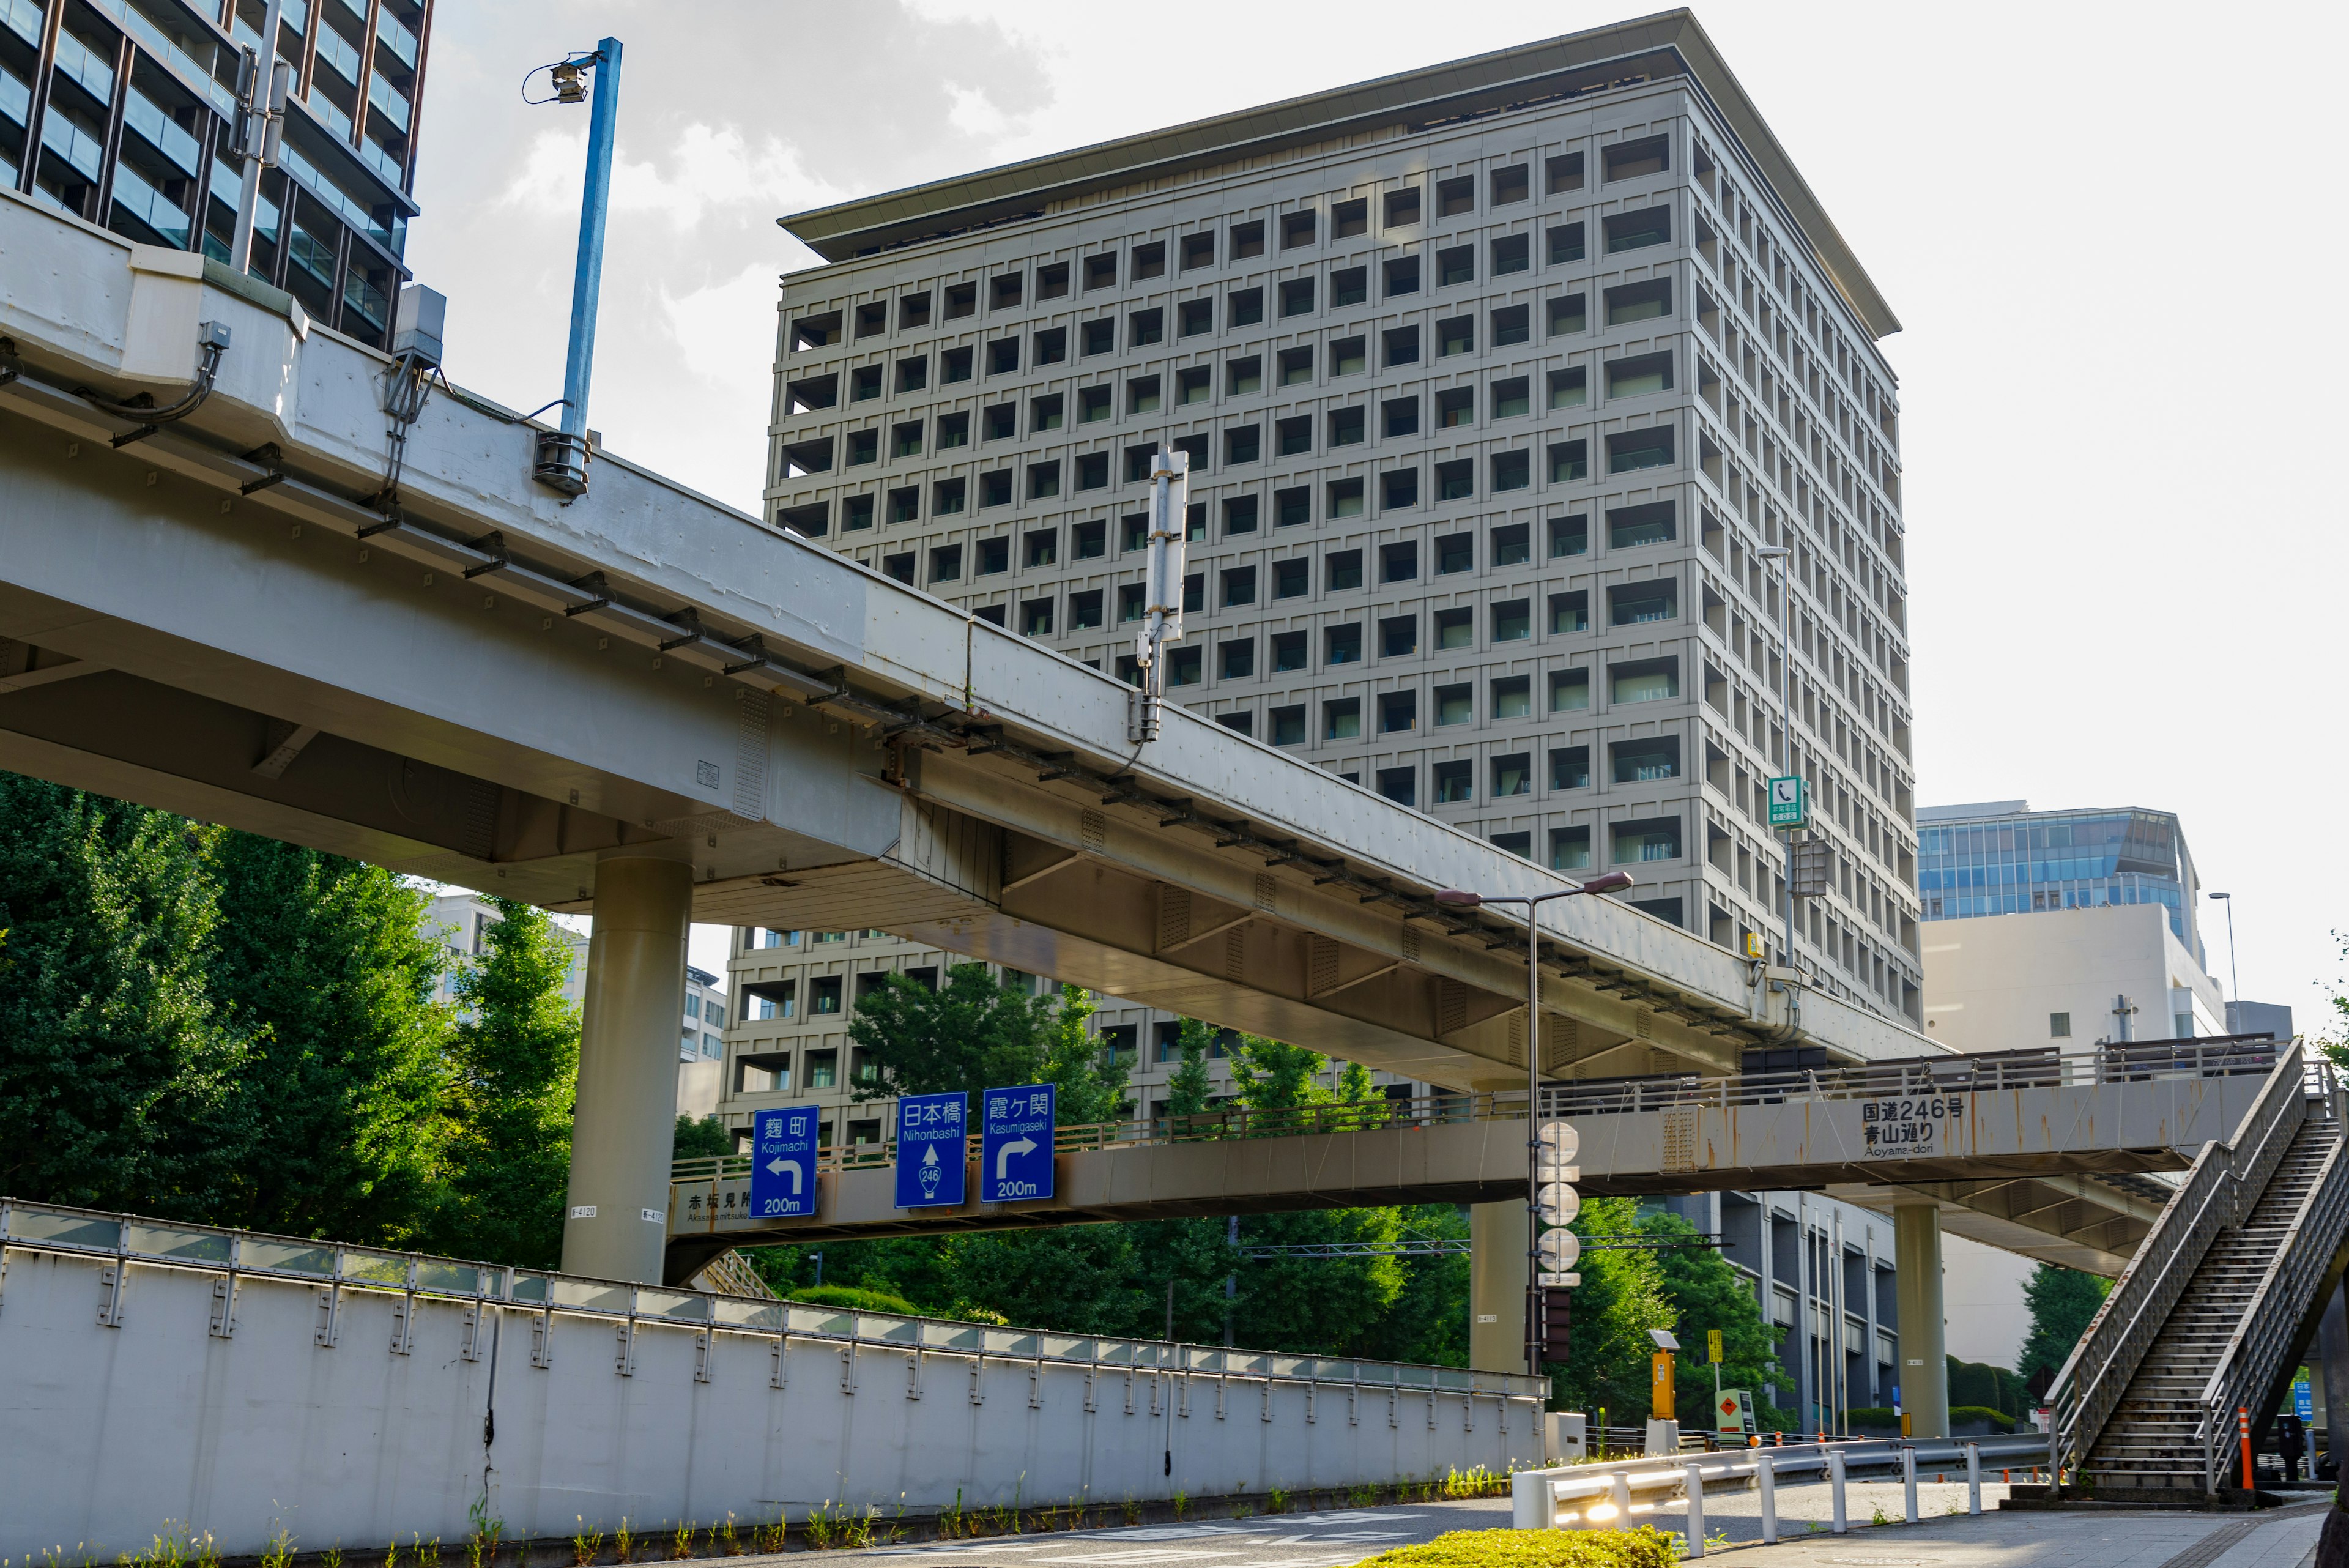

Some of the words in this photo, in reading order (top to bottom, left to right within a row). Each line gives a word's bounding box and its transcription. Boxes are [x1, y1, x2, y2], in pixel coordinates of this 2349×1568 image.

[1772, 804, 1797, 813] 非常電話
[904, 1101, 962, 1127] 日本橋
[1863, 1098, 1964, 1123] 国道246号
[904, 1126, 960, 1142] Nihonbashi
[990, 1118, 1047, 1135] Kasumigaseki
[1863, 1122, 1934, 1145] 青山通り
[761, 1139, 809, 1155] Kojimachi
[1864, 1143, 1934, 1159] Aoyama-dori
[921, 1169, 938, 1183] 246
[998, 1180, 1036, 1197] 200m
[764, 1198, 800, 1213] 200m
